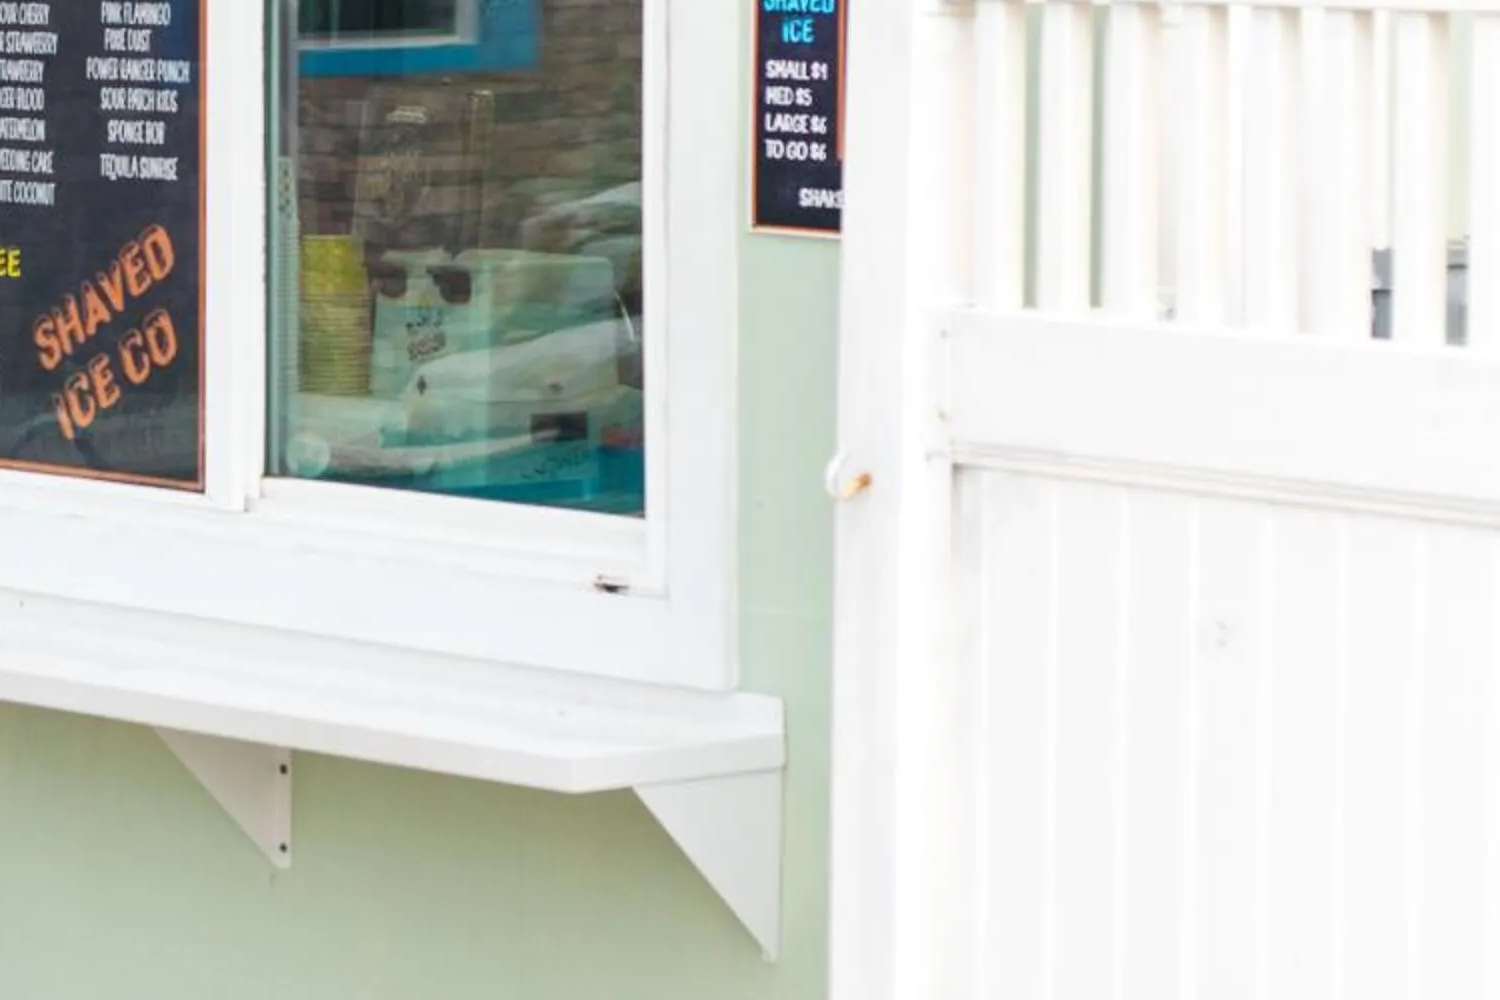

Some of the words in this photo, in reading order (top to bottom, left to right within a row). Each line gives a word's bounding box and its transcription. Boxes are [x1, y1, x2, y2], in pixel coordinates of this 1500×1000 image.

[19, 2, 50, 25] CHERRY
[123, 1, 171, 26] FLAMINGO
[782, 17, 815, 44] ICE
[86, 56, 119, 80] POWER
[157, 59, 191, 84] PUNCH
[765, 59, 810, 81] SMALL
[100, 87, 127, 111] SOUR
[127, 87, 156, 112] PATCH
[795, 88, 813, 107] $5
[107, 119, 145, 144] SPONGE
[764, 112, 810, 134] LARGE
[31, 150, 55, 174] CAKE
[763, 138, 785, 160] TO
[786, 140, 809, 161] GO
[99, 153, 139, 181] TEQUILA
[13, 180, 56, 205] COCONUT
[32, 224, 176, 371] SHAVED
[53, 353, 122, 440] ICE
[118, 308, 178, 385] CO
